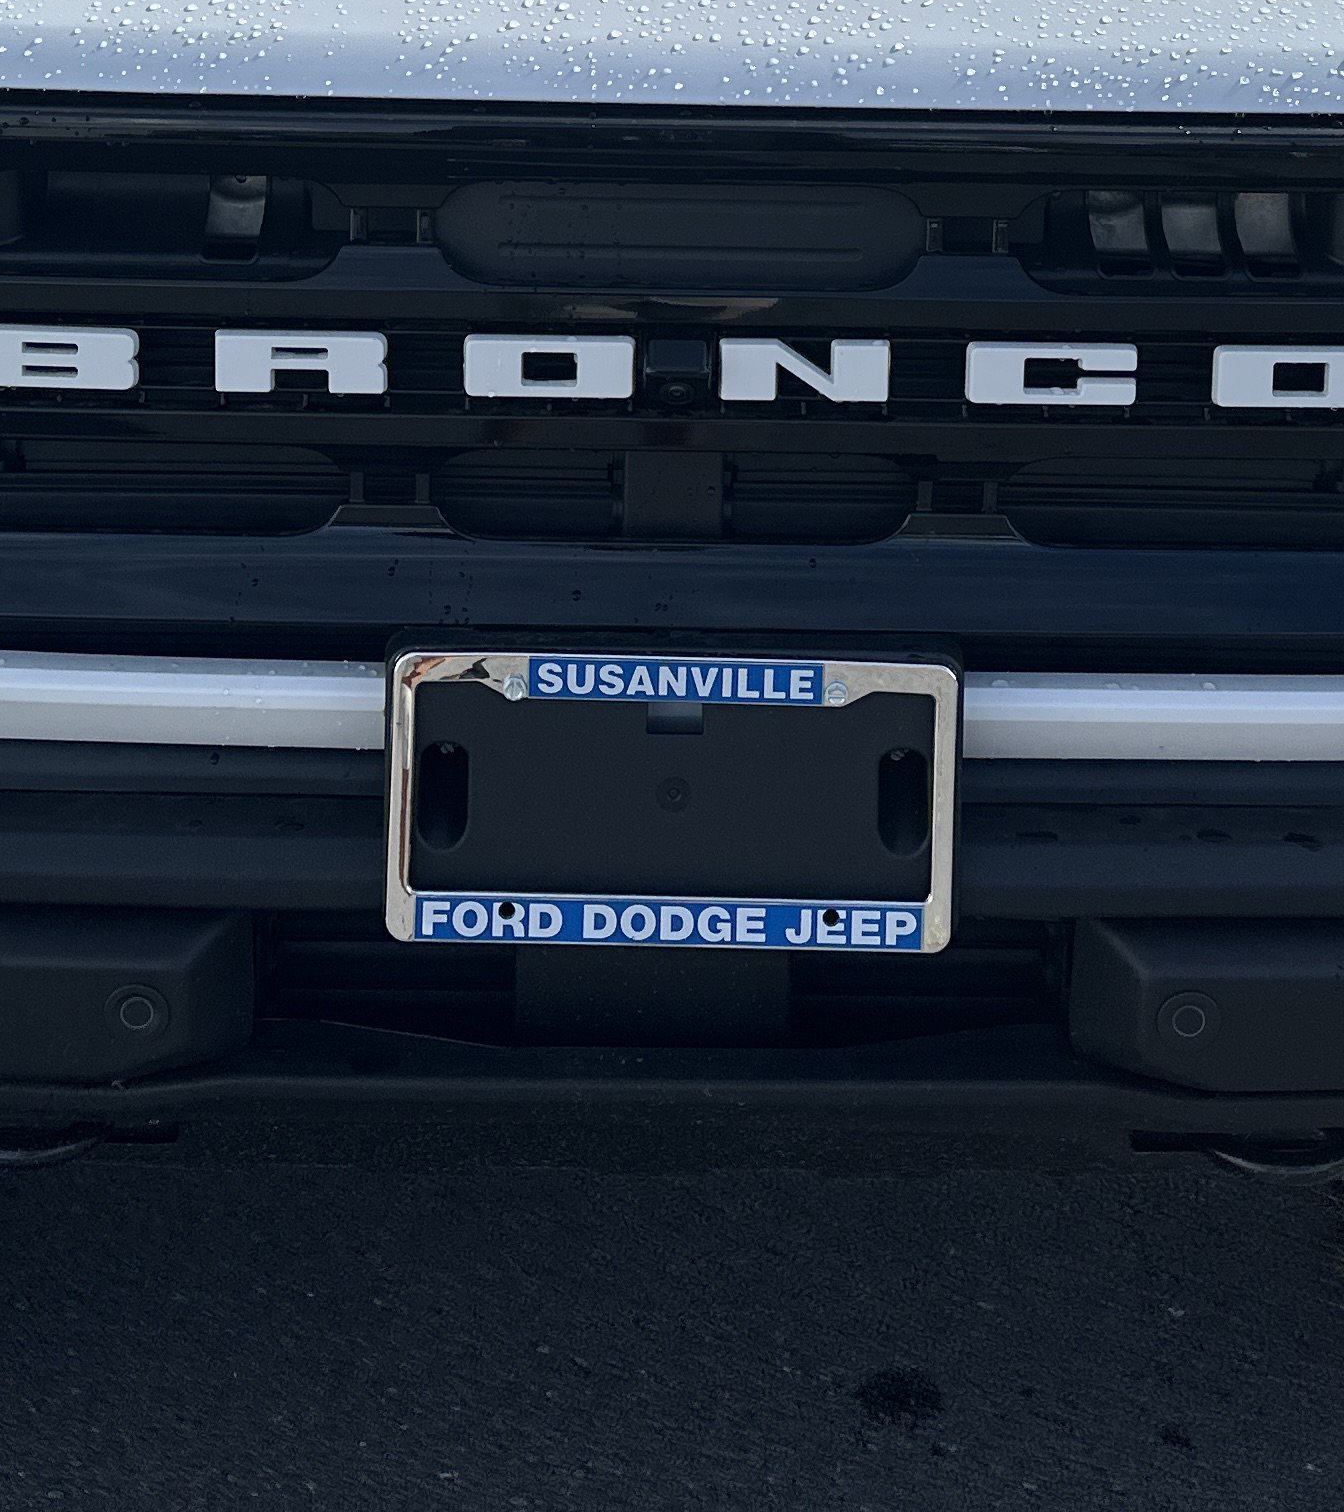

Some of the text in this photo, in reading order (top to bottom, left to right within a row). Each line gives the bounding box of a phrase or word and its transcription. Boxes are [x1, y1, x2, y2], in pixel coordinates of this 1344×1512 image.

[537, 662, 814, 701] SUSANVILLE
[422, 900, 918, 946] FORD DODGE JEEP
